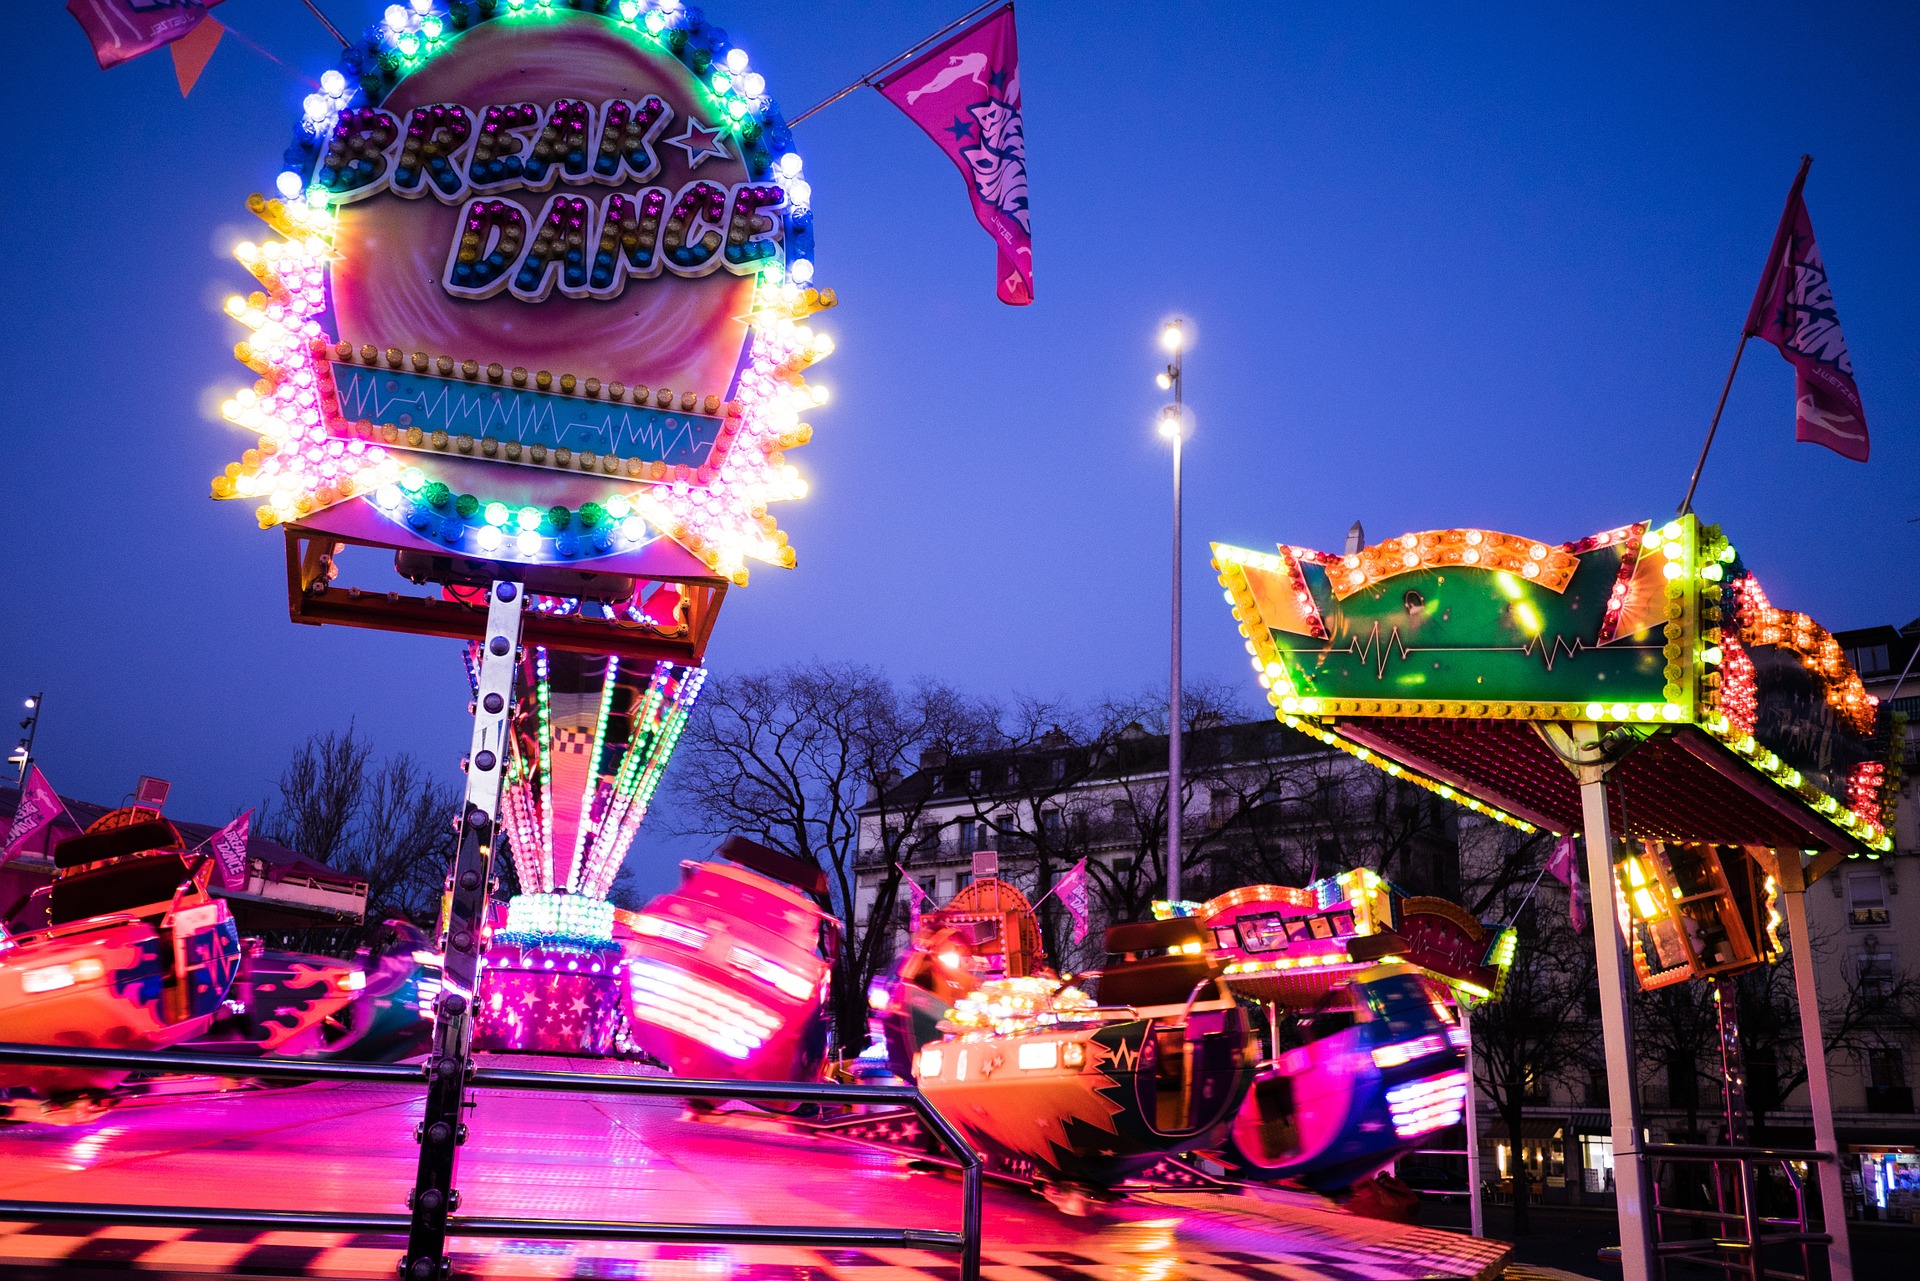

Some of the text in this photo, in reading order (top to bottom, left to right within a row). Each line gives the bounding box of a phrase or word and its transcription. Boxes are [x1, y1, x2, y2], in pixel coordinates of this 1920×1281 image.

[317, 95, 673, 205] BREAK
[442, 180, 789, 303] DANCE
[1811, 366, 1860, 408] J.WETZEL
[216, 841, 245, 876] DANCE
